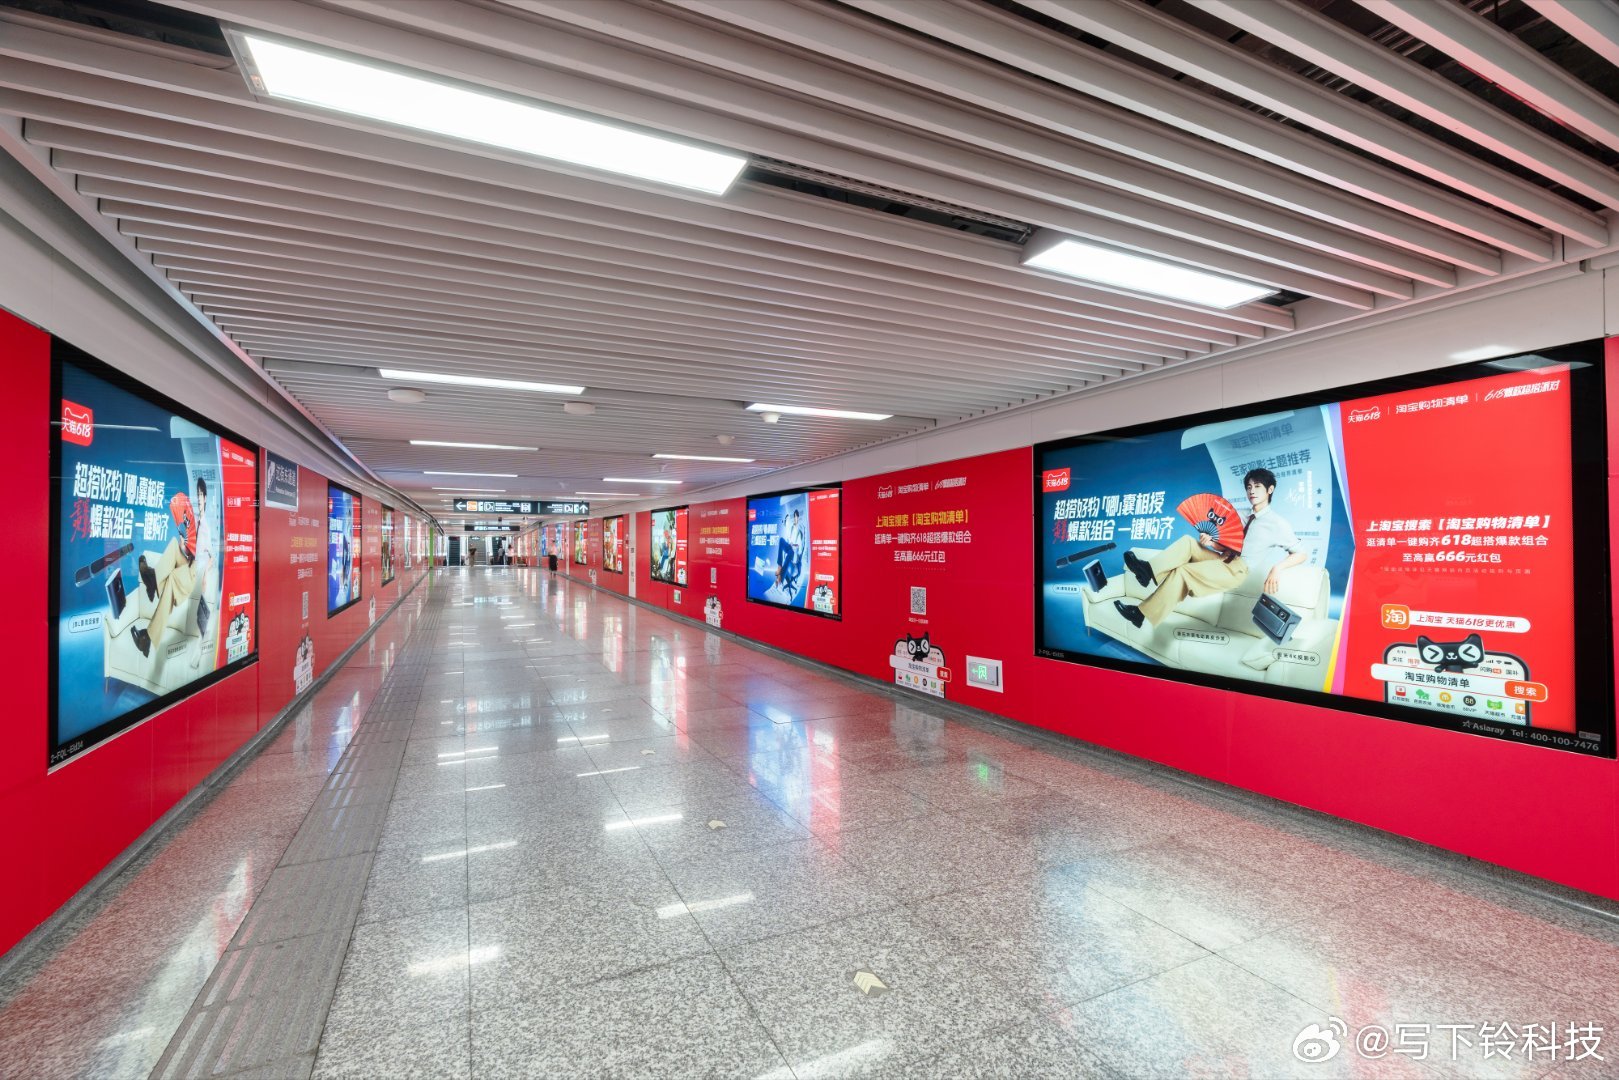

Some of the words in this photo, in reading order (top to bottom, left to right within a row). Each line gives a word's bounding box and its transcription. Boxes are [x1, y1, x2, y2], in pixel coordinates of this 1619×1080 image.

[1348, 411, 1381, 423] 天猫618
[1396, 394, 1469, 414] 淘宝购物清单
[61, 417, 91, 438] 天猫618
[1066, 520, 1116, 541] 爆款组合
[1366, 534, 1549, 547] 逛清单一键购齐618超搭爆款组合
[1402, 551, 1502, 563] 至高赢666元红包
[1385, 608, 1407, 625] 淘
[1416, 613, 1444, 625] 上淘宝
[1446, 616, 1516, 629] 天猫618更优惠
[1404, 671, 1471, 688] 淘宝购物清单
[1513, 685, 1537, 697] 搜索
[1472, 722, 1505, 736] Asiaray
[1530, 732, 1600, 751] 400-100-7476
